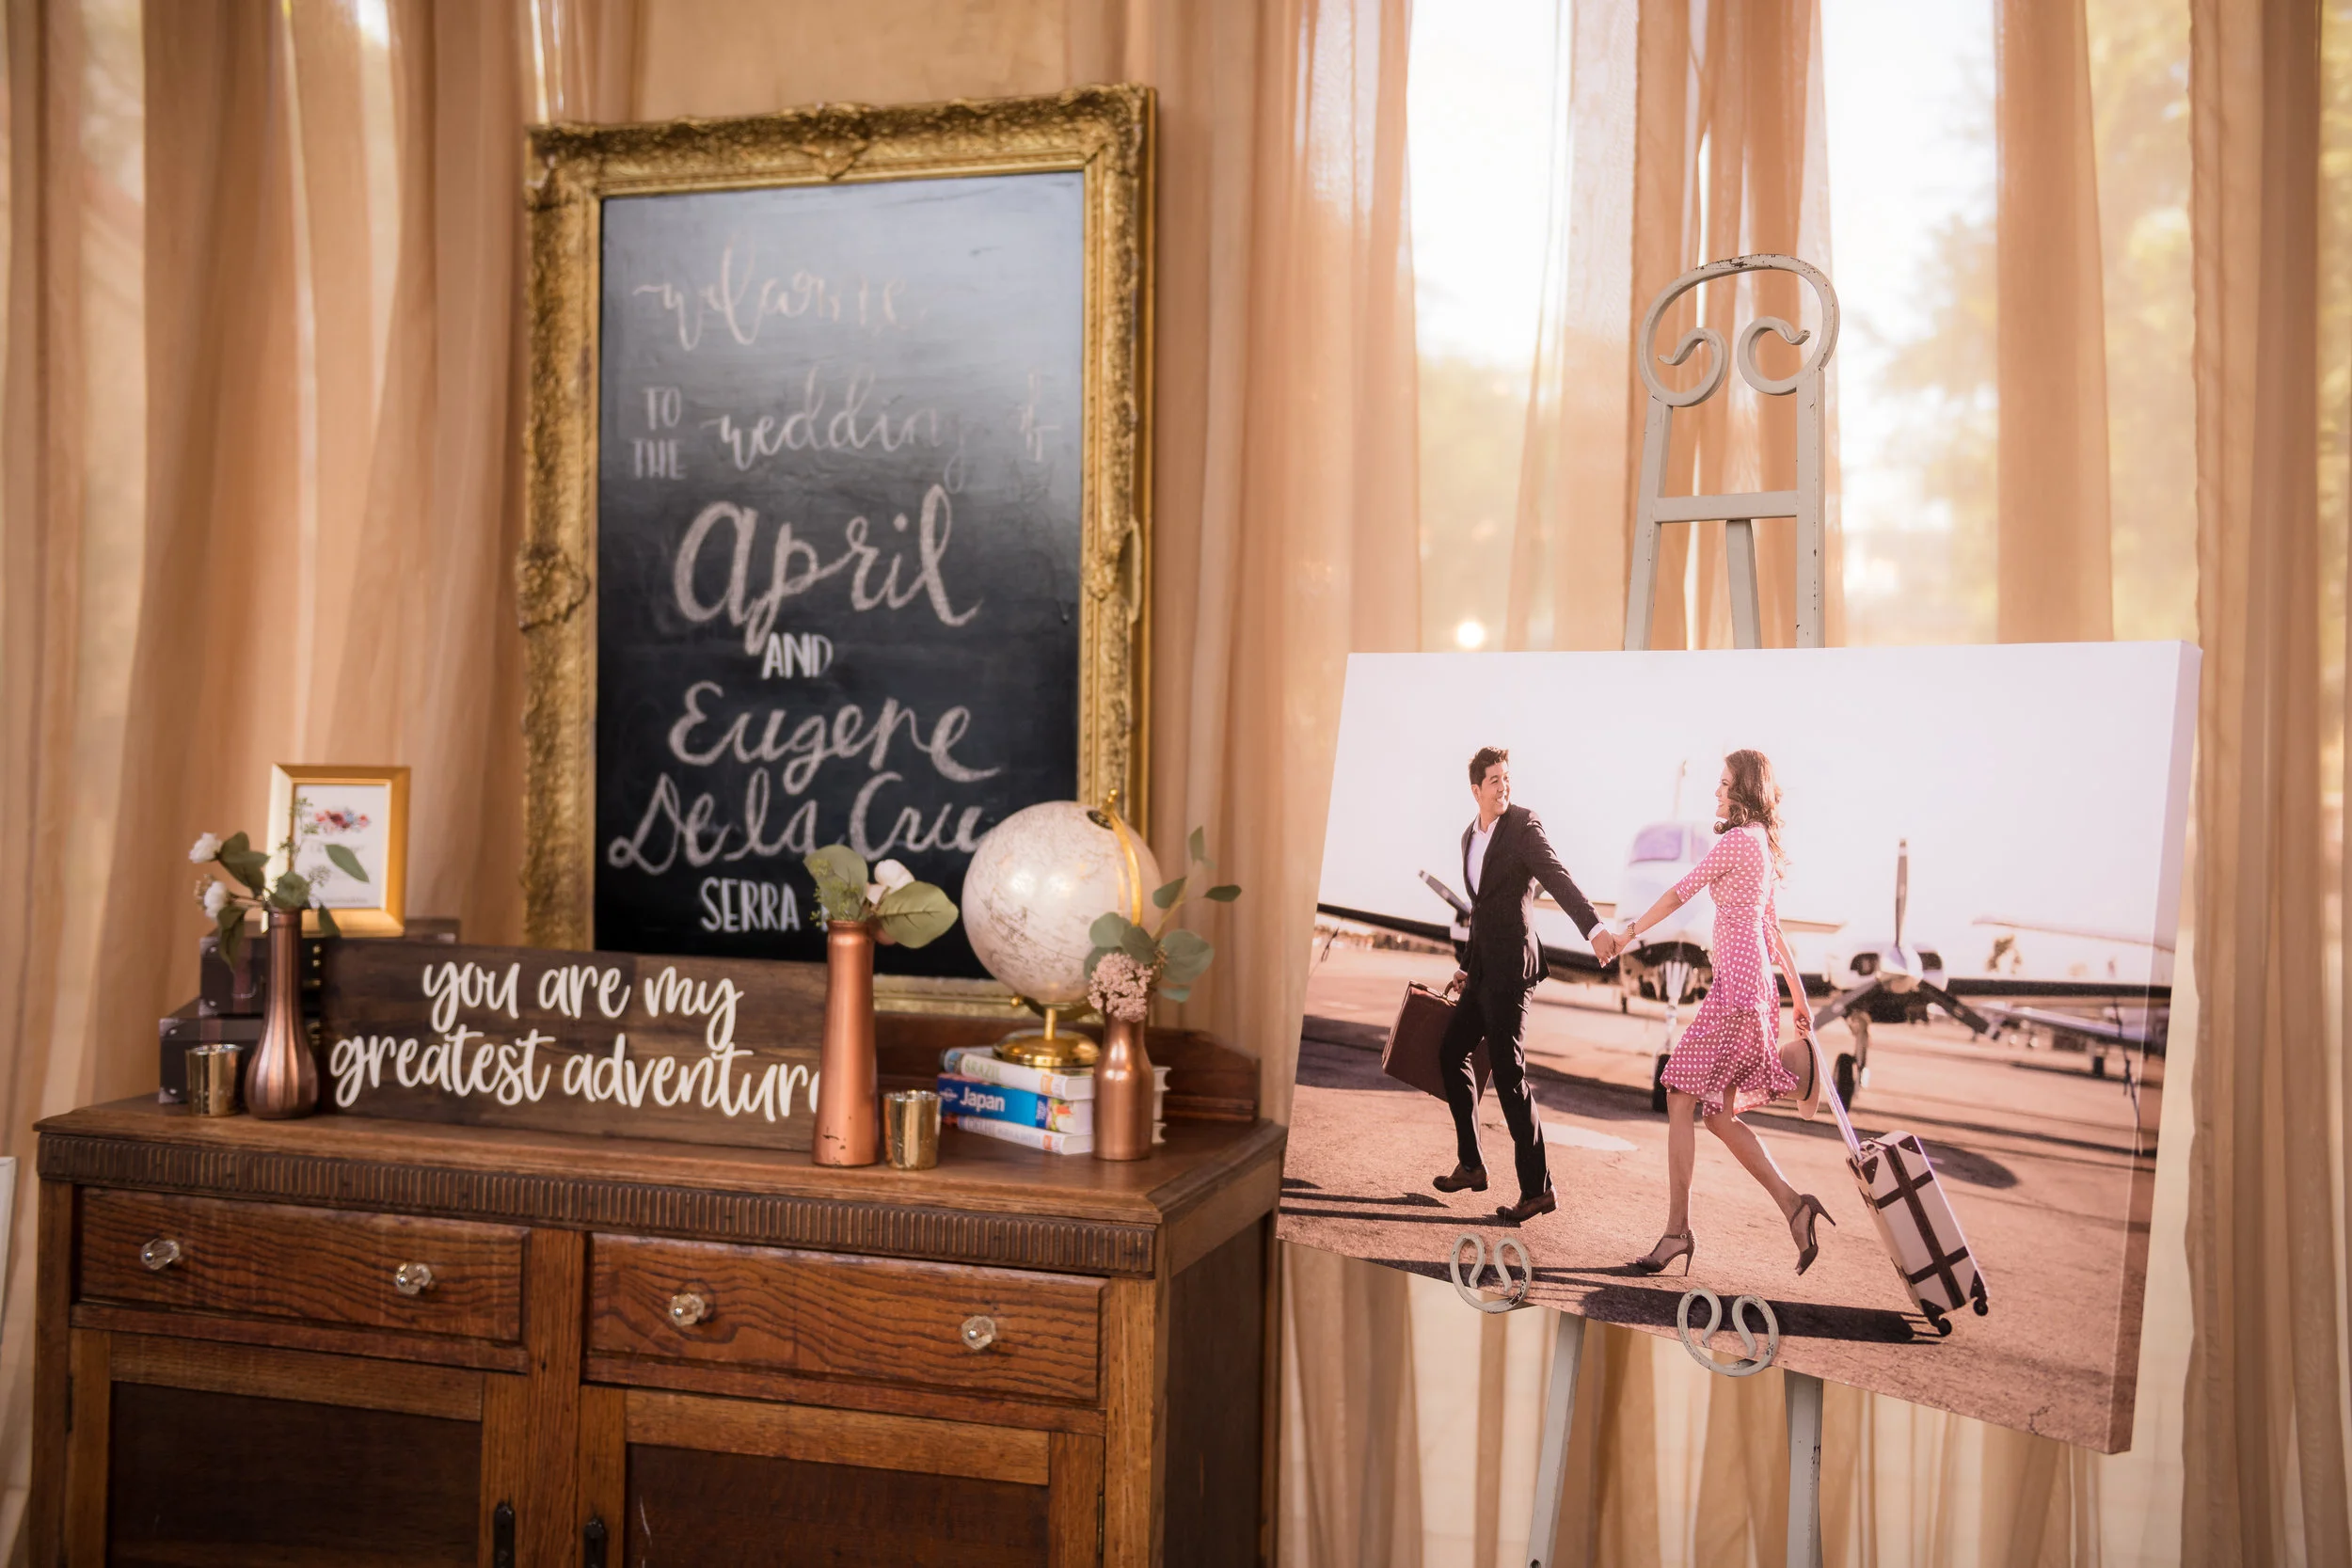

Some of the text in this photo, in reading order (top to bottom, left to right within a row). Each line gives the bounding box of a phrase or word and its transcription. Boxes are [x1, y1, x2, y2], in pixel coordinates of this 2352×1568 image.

[643, 387, 682, 431] TO
[633, 438, 685, 480] THE
[674, 484, 983, 657] April
[760, 632, 834, 679] AND
[669, 681, 1001, 795] Eugene
[609, 772, 733, 875] De
[850, 771, 997, 862] Cru
[700, 877, 800, 932] SERRA
[423, 961, 743, 1051] you are my
[330, 1024, 556, 1108] greatest
[960, 1086, 1006, 1112] Japan
